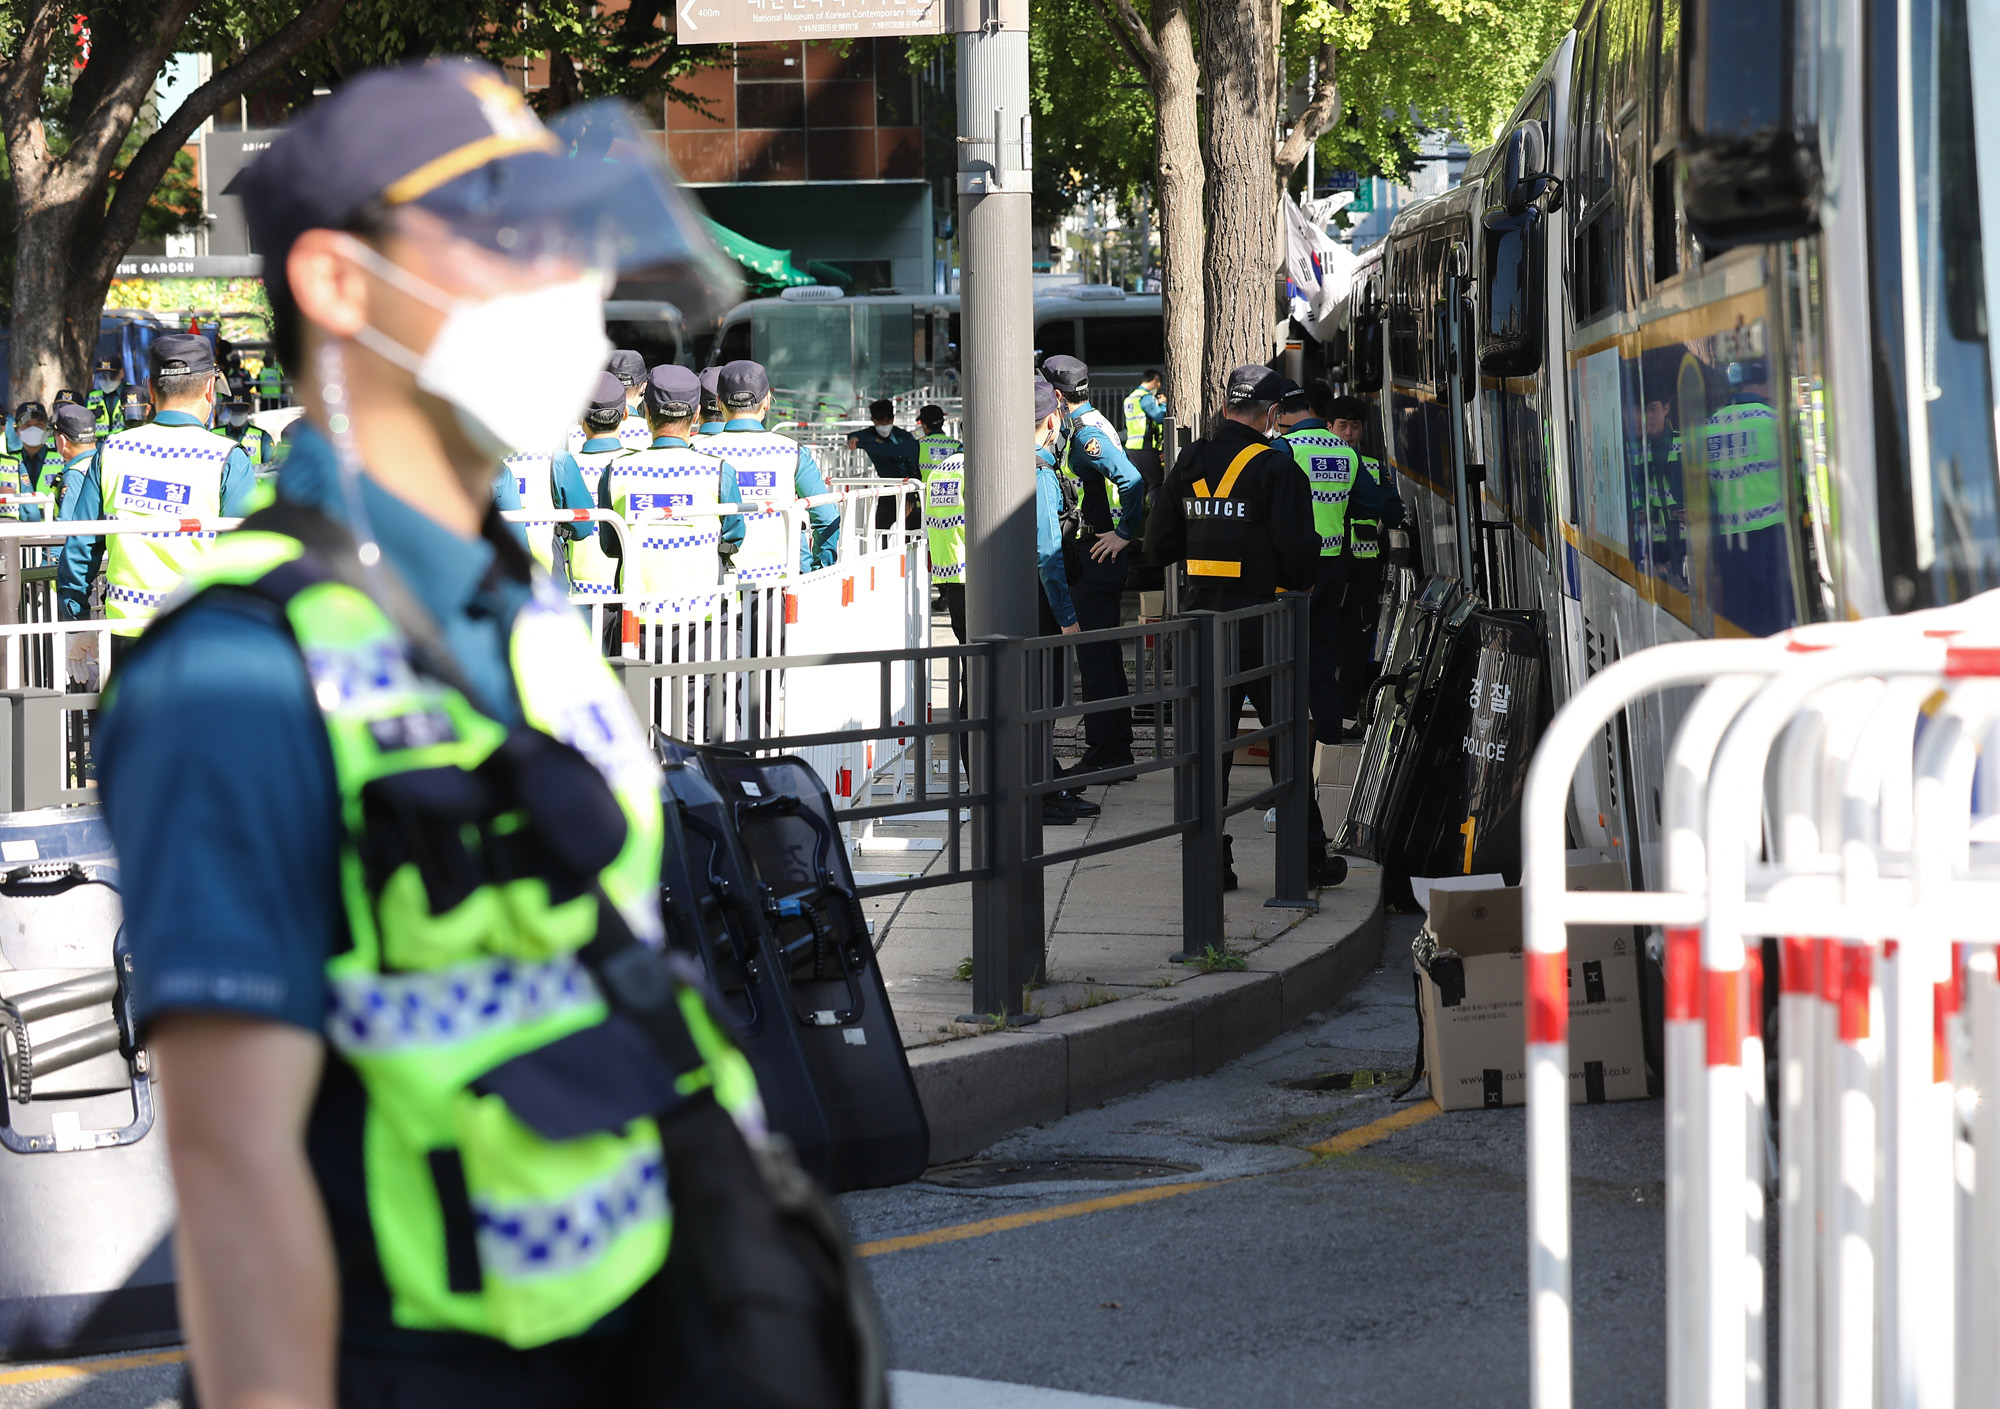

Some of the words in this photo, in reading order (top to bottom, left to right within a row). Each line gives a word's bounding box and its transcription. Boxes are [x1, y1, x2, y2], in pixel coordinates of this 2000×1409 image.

[698, 8, 720, 17] 400m
[752, 13, 783, 23] National
[784, 12, 814, 21] Museum
[815, 11, 824, 20] of
[825, 10, 851, 19] Korean
[852, 9, 905, 19] Contemporary
[906, 7, 933, 17] History
[116, 263, 138, 275] THE
[140, 262, 195, 274] GARDEN
[1232, 390, 1252, 399] POLICE
[1315, 458, 1348, 472] 경찰
[736, 472, 773, 487] 찰
[1315, 472, 1349, 480] POLICE
[128, 476, 187, 504] 경찰
[741, 488, 772, 496] LICE
[931, 482, 956, 495] 경찰
[124, 497, 183, 515] POLICE
[931, 496, 955, 504] POLICE
[1186, 500, 1246, 518] POLICE
[1469, 677, 1512, 714] 경찰
[1462, 735, 1506, 762] POLICE
[1459, 815, 1476, 875] 1
